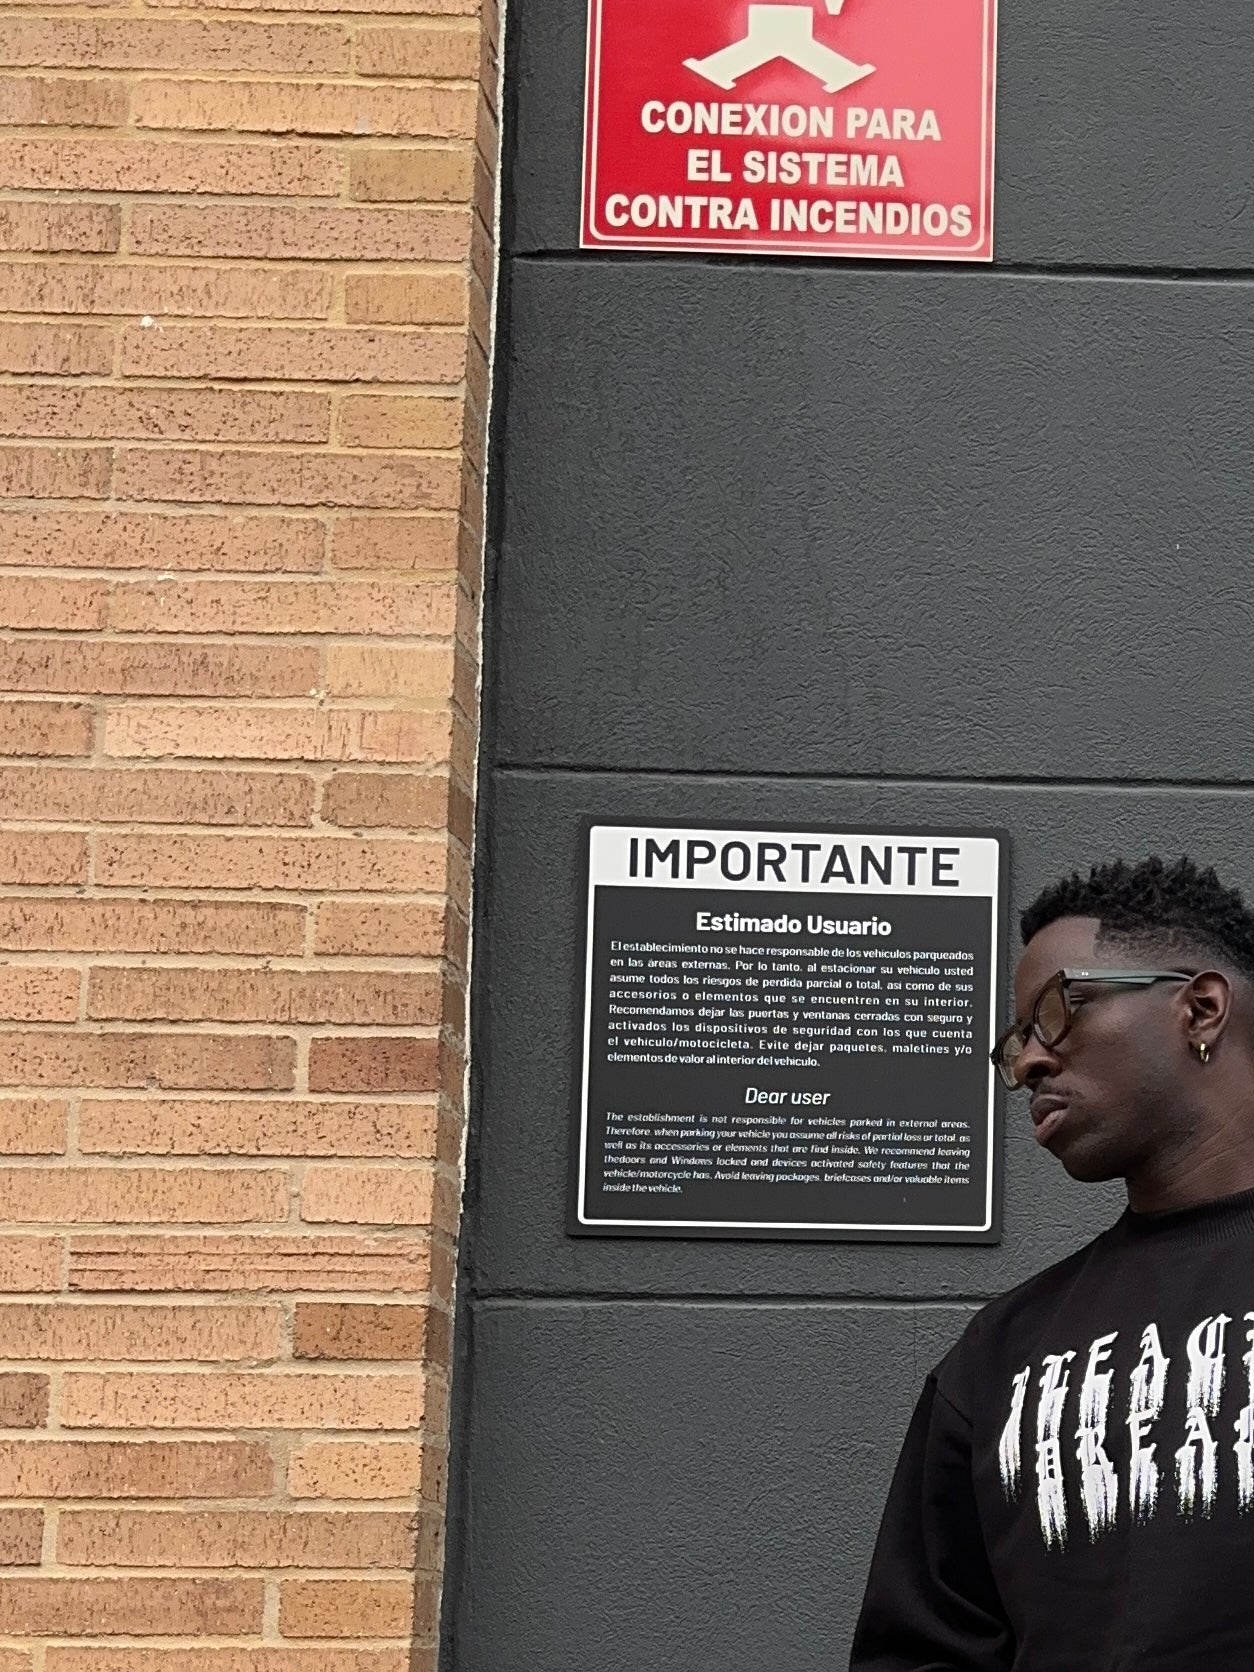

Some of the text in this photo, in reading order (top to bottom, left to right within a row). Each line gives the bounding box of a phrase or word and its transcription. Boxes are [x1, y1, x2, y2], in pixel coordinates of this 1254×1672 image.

[641, 100, 942, 141] CONEXION PARA
[687, 149, 905, 187] EL SISTEMA
[604, 193, 973, 237] CONTRA INCENDIOS
[628, 837, 960, 887] IMPORTANTE
[696, 911, 893, 937] Estimado Usuario
[611, 940, 621, 951] El
[623, 941, 708, 953] establecimiento
[710, 945, 723, 954] no
[725, 946, 737, 954] se
[739, 944, 764, 955] hace
[766, 944, 829, 959] responsable
[832, 946, 844, 957] de
[847, 946, 861, 957] los
[913, 948, 973, 962] parqueados
[610, 958, 623, 967] en
[628, 957, 643, 968] las
[648, 957, 677, 968] áreas
[682, 958, 730, 970] externas.
[736, 959, 753, 970] Por
[758, 960, 767, 971] lo
[807, 961, 816, 972] al
[821, 962, 876, 974] estacionar
[881, 966, 893, 974] su
[945, 965, 973, 976] usted
[610, 974, 645, 984] asume
[650, 973, 679, 984] todos
[683, 974, 699, 985] los
[703, 974, 741, 988] riesgos
[746, 975, 758, 986] de
[806, 977, 841, 990] parcial
[845, 980, 852, 988] o
[906, 982, 934, 990] como
[938, 980, 951, 991] de
[955, 983, 973, 991] sus
[609, 988, 972, 1007] accesorios o elementos que se encuentren en su interior.
[609, 1004, 972, 1025] Recomendamos dejar las puertas y ventanas cerradas con seguro y
[608, 1020, 972, 1039] activados los dispositivos de seguridad con los que cuenta
[608, 1036, 618, 1047] el
[759, 1039, 789, 1050] Evite
[795, 1040, 824, 1053] dejar
[893, 1042, 949, 1053] maletines
[954, 1043, 972, 1056] y/o
[607, 1052, 663, 1063] elementos
[665, 1053, 678, 1064] de
[679, 1053, 704, 1064] valor
[706, 1054, 715, 1065] al
[716, 1054, 755, 1065] interior
[757, 1055, 772, 1066] del
[744, 1087, 831, 1106] Dear user
